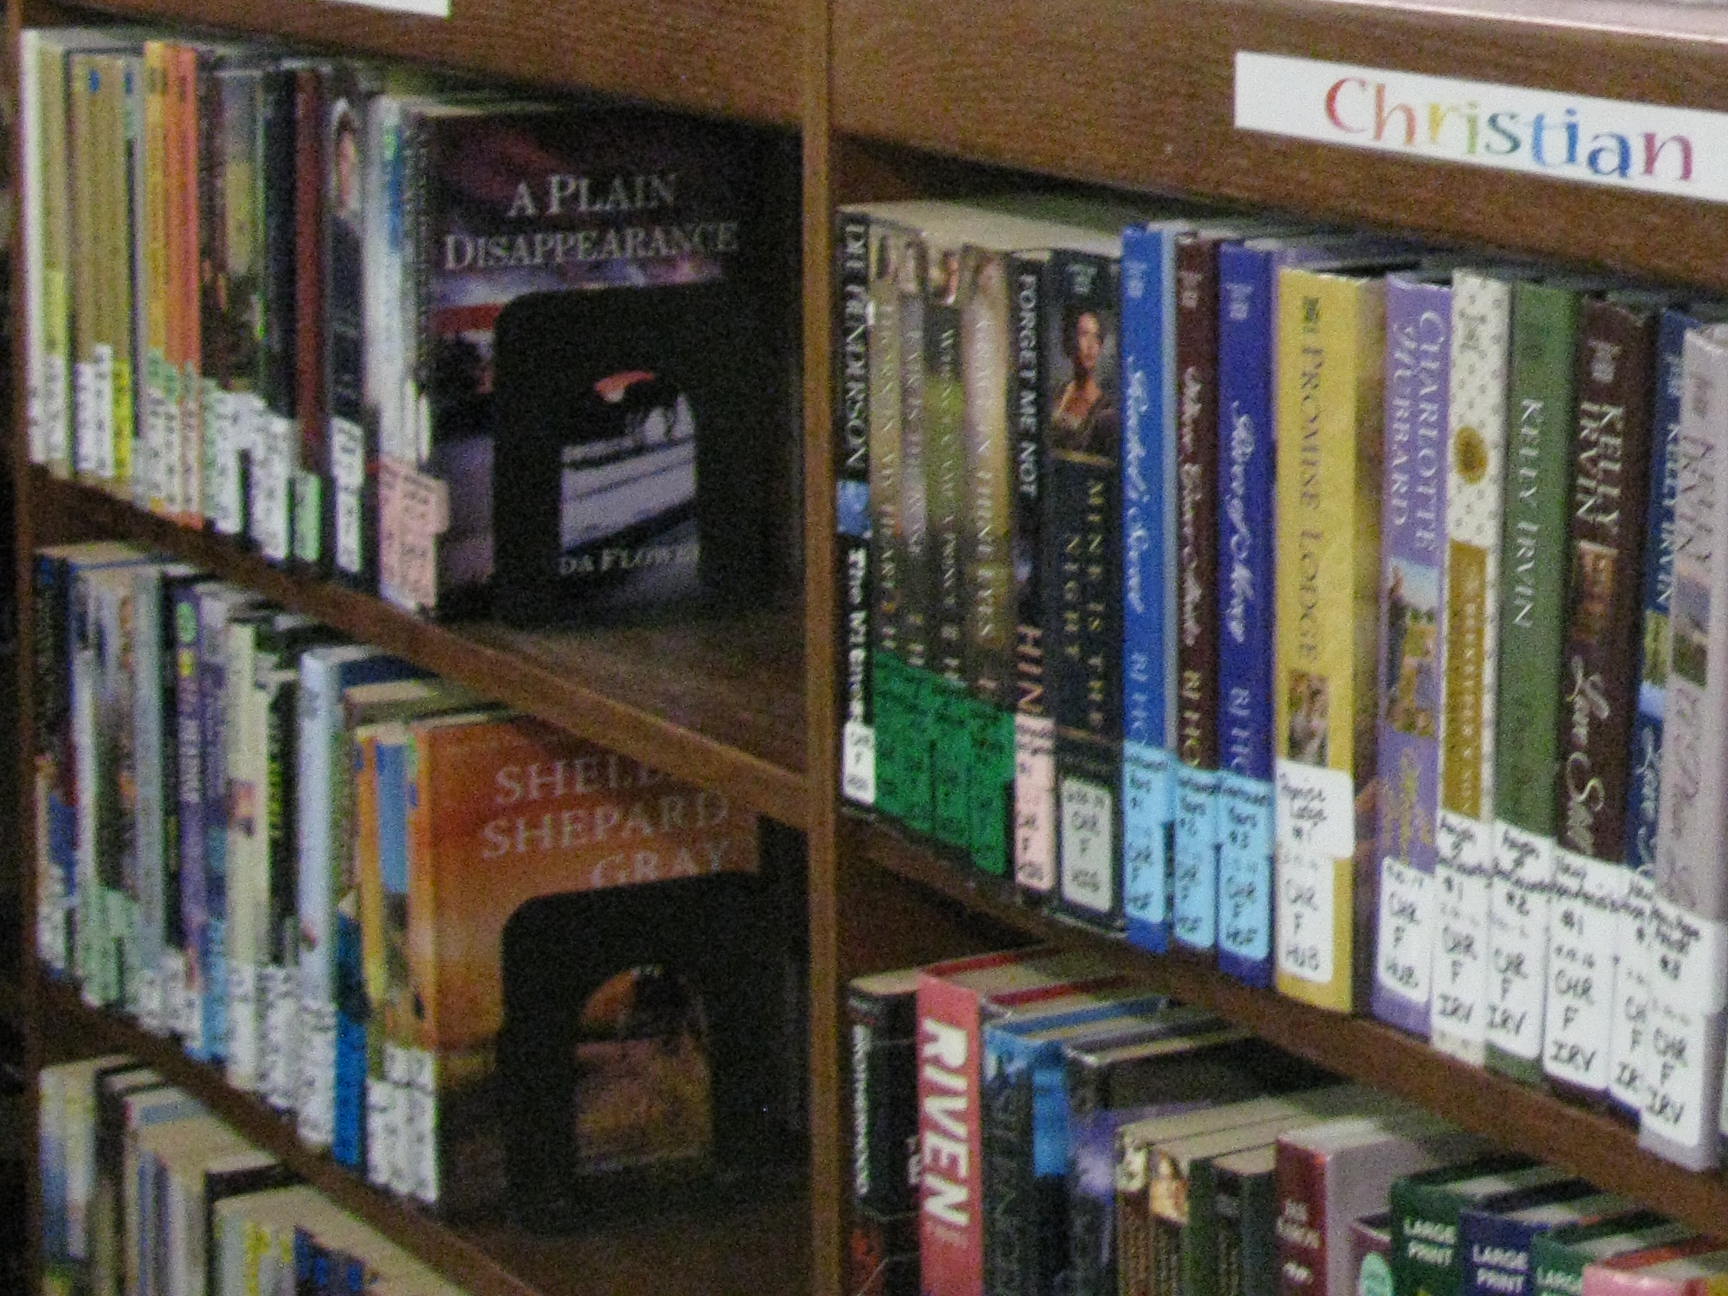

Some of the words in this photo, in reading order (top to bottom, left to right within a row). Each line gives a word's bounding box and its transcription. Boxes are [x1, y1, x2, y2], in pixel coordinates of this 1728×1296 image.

[1323, 75, 1695, 183] Christian
[508, 182, 537, 217] A
[545, 173, 678, 216] PLAIN
[443, 221, 738, 270] DISAPPEARANCE
[1018, 273, 1039, 384] FORGET
[844, 282, 868, 470] HENDERSON
[1018, 390, 1039, 433] ME
[1300, 344, 1325, 510] PROMISE
[1391, 322, 1419, 526] HUBBARD
[1415, 310, 1446, 552] CHARLOTTE
[1517, 398, 1545, 510] KELLY
[1018, 441, 1039, 498] NOT
[1574, 400, 1602, 523] IRVIN
[1596, 402, 1625, 536] KELLY
[1087, 479, 1105, 582] MINE
[976, 567, 995, 640] EYES
[1063, 535, 1081, 661] NIGHT
[1512, 520, 1540, 629] IRVIN
[1087, 602, 1105, 632] IS
[1087, 653, 1105, 728] THE
[482, 790, 729, 860] SHEPARD
[590, 839, 729, 889] GRAY
[1550, 1037, 1598, 1074] IRV
[1562, 1005, 1580, 1032] F
[922, 1017, 971, 1228] RIVEN
[1403, 1217, 1456, 1245] LARGE
[1408, 1240, 1453, 1268] PRINT
[1472, 1244, 1528, 1271] LARGE
[1477, 1267, 1526, 1295] PRINT
